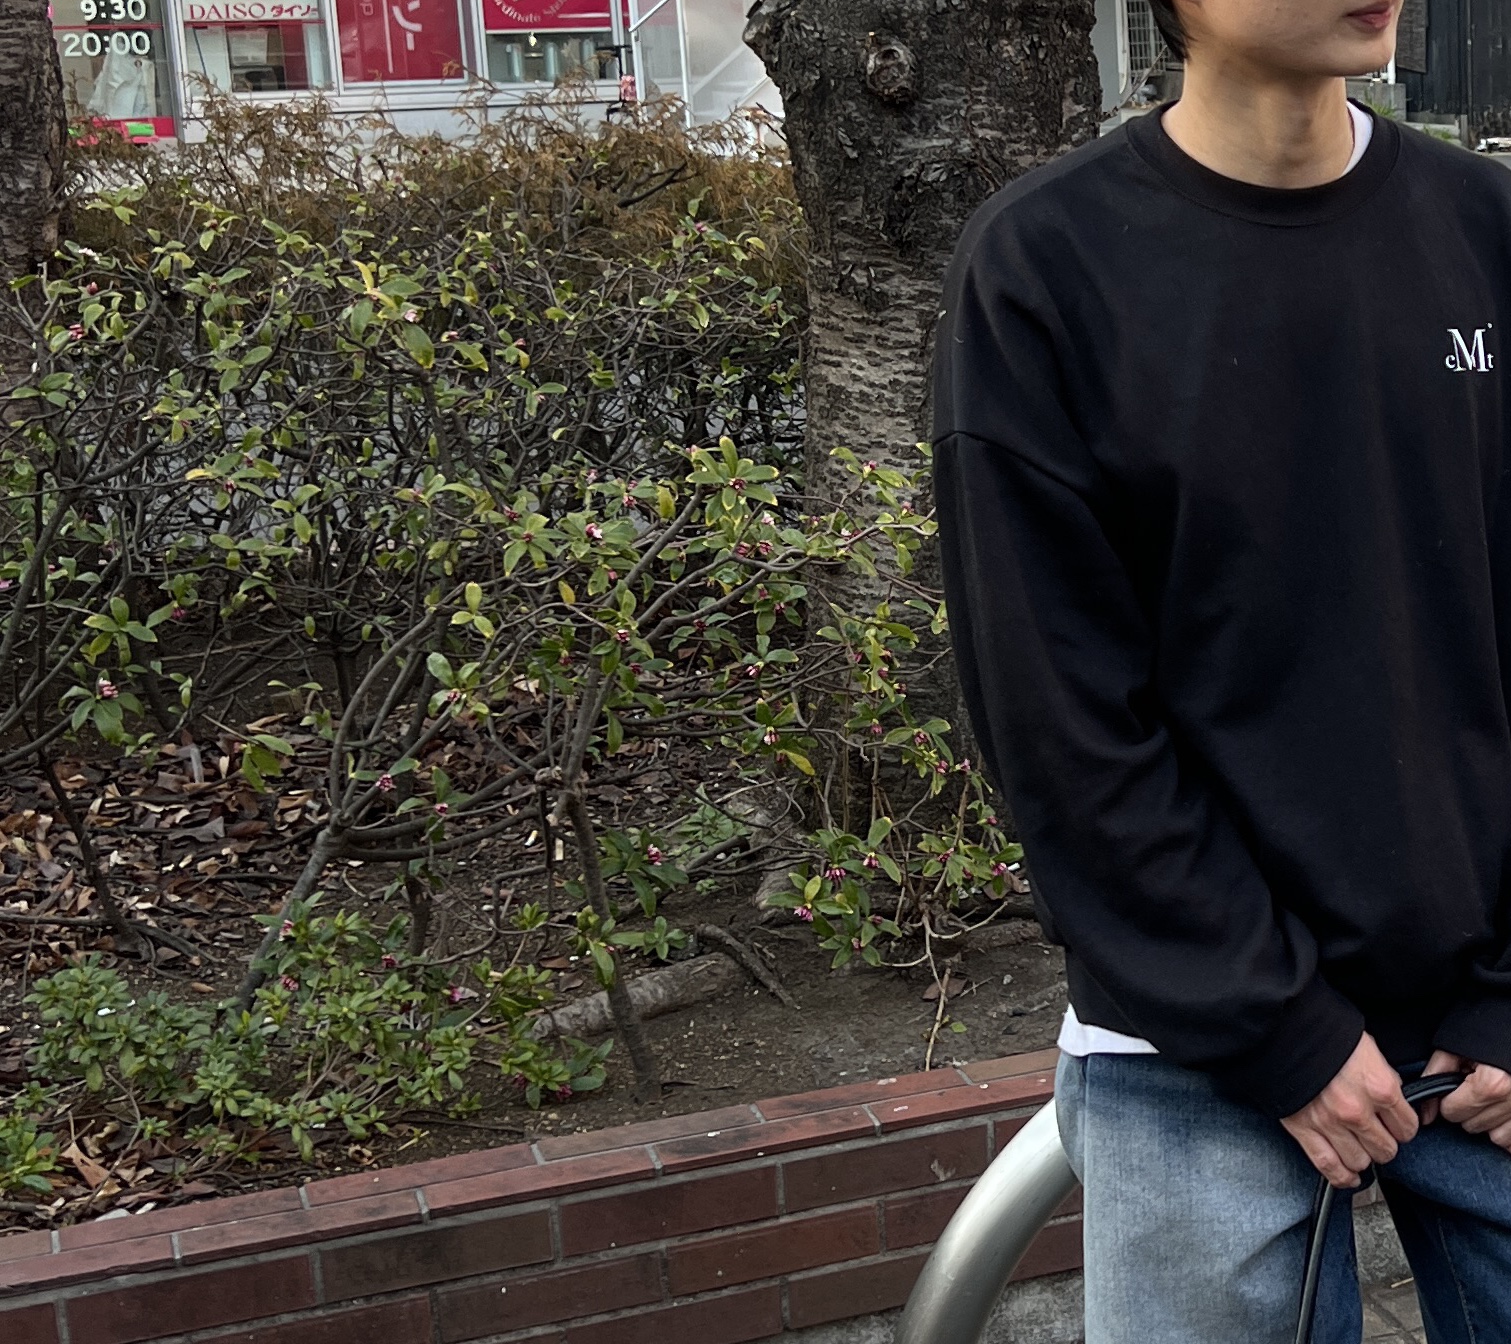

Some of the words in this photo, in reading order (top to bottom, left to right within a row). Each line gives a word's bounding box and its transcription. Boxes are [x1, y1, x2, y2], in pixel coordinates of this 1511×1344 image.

[189, 2, 266, 20] DAISO
[270, 3, 319, 17] ダイソー
[62, 31, 151, 57] 20:00
